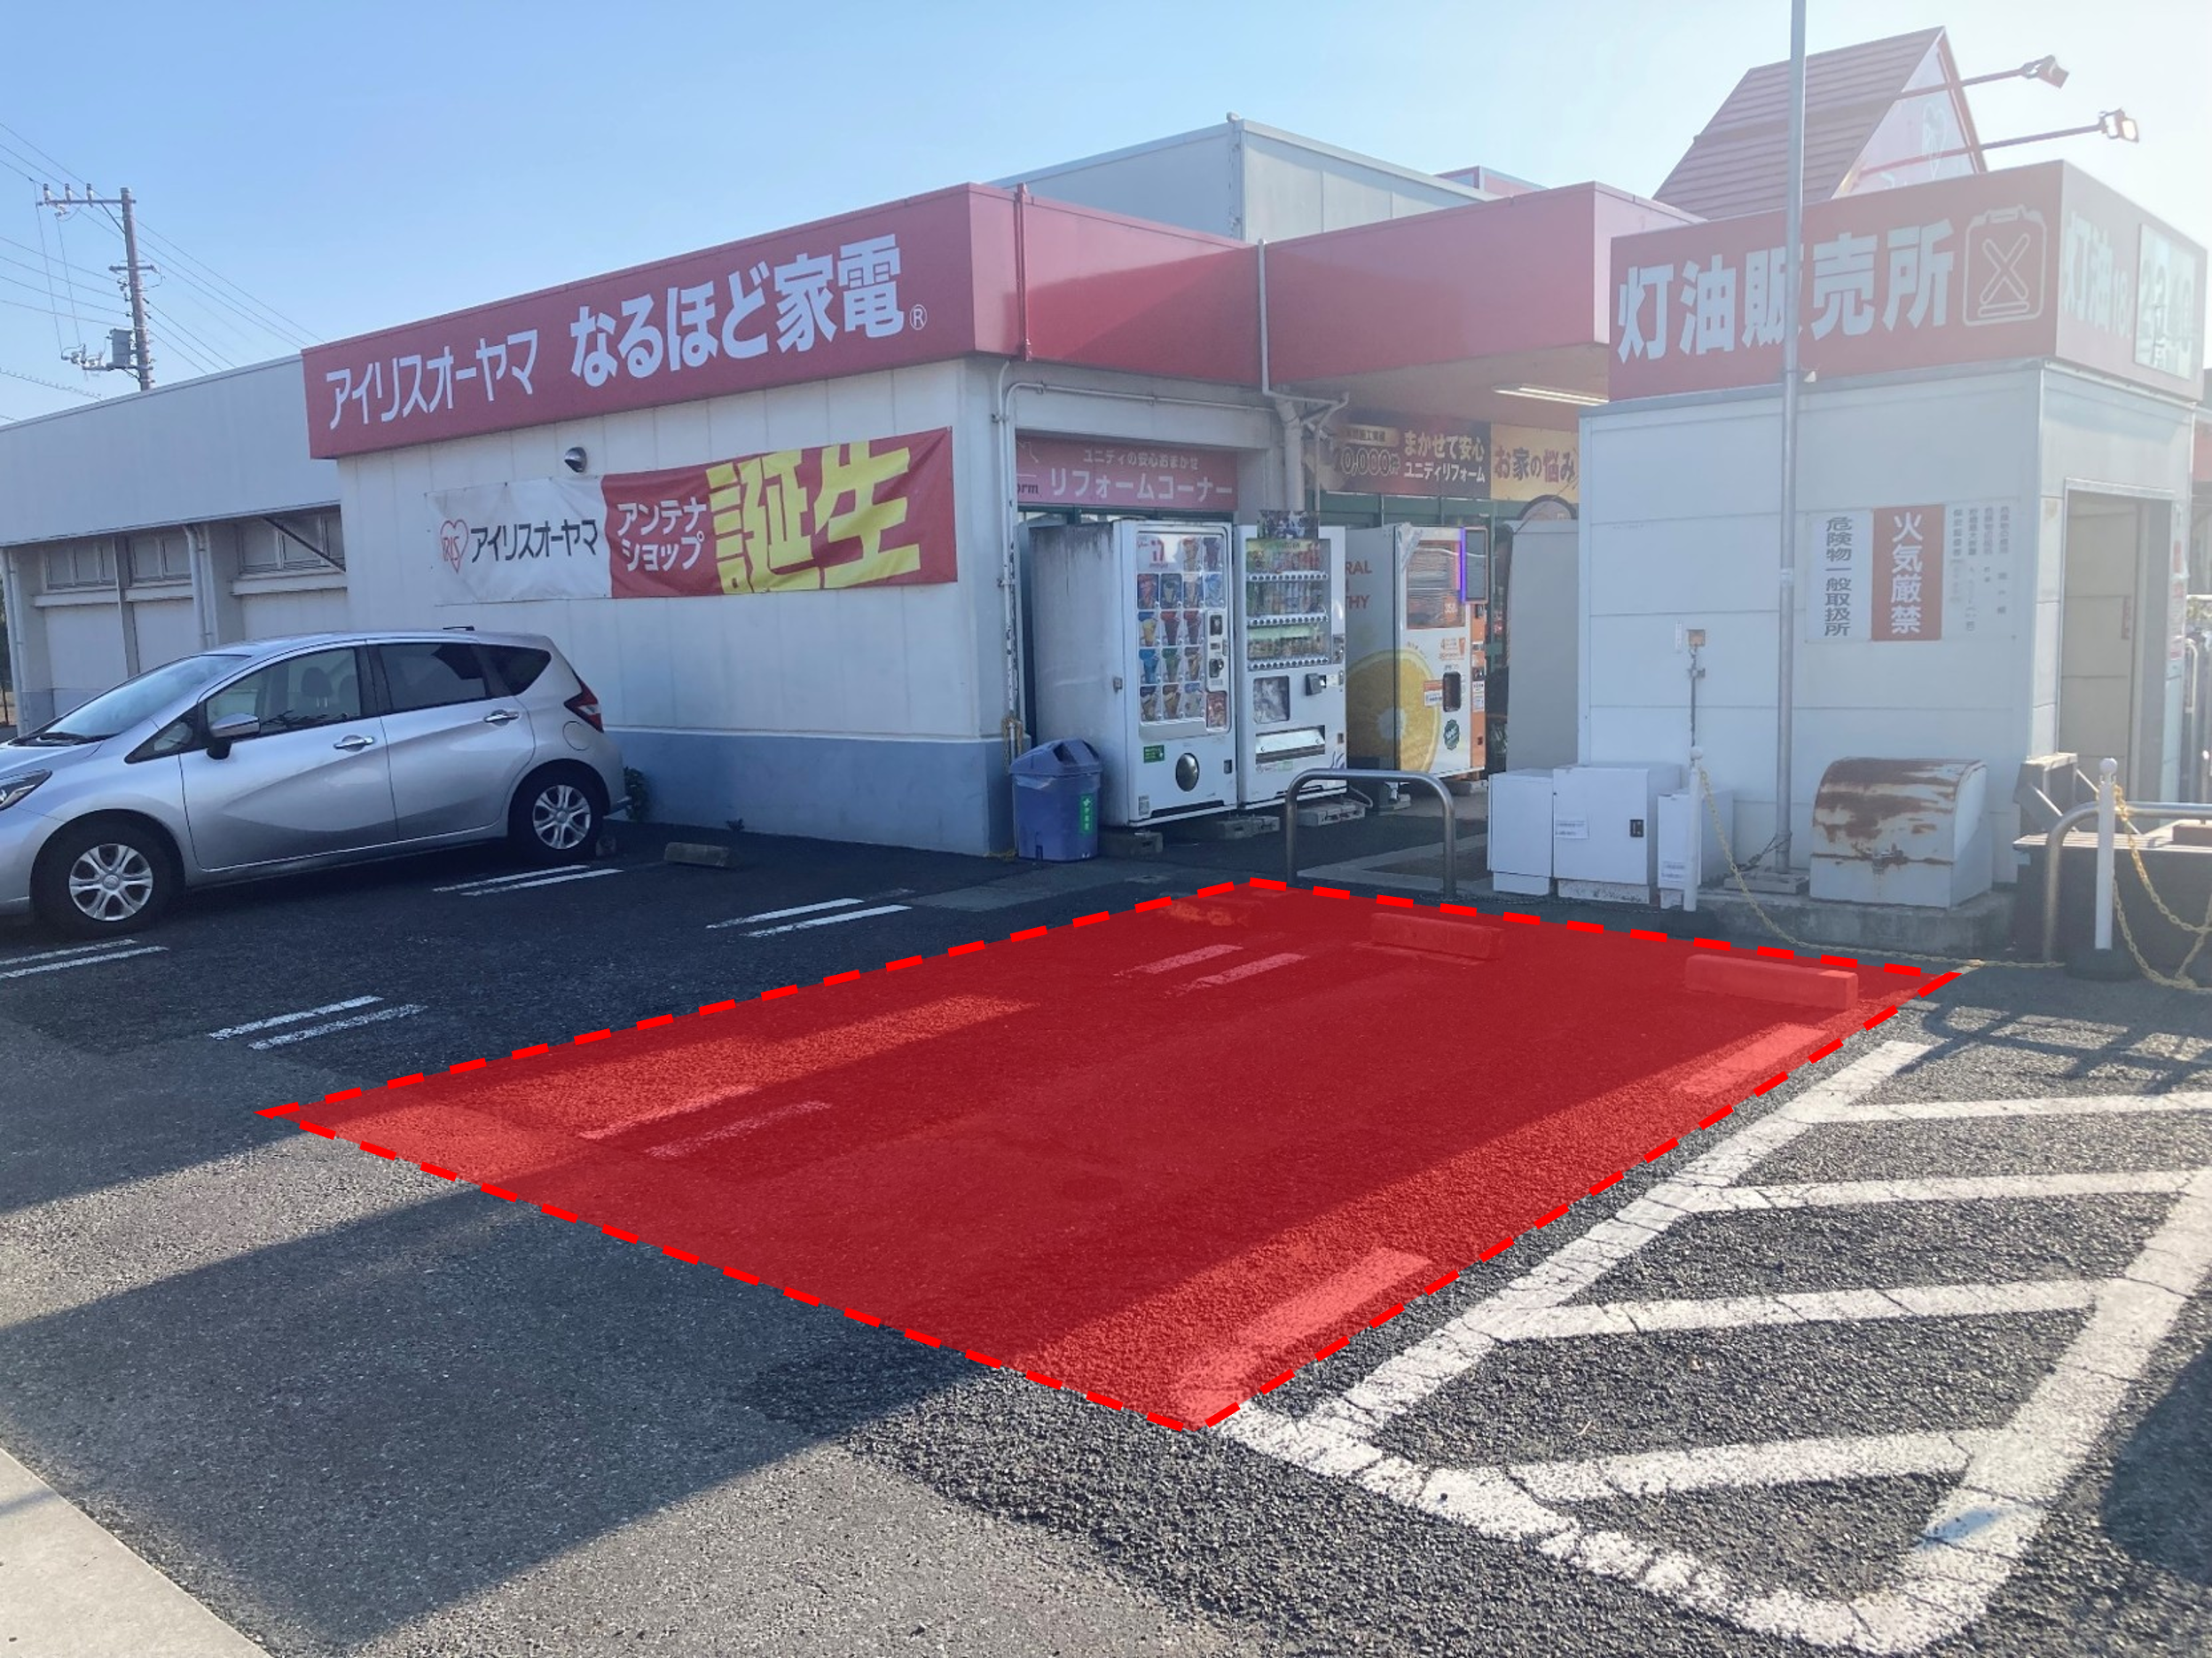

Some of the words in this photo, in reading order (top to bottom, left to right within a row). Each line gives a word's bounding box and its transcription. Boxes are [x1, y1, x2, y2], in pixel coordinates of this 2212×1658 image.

[1617, 222, 1955, 363] 灯油販売所
[326, 330, 537, 429] アイリスオーヤマ
[1404, 430, 1484, 461] まかせて安心
[1051, 468, 1233, 503] リフォームコーナー
[1404, 461, 1486, 483] ユニディリフォーム
[617, 498, 707, 535] アンテナ
[707, 441, 921, 593] 誕生
[470, 520, 598, 563] アイリスオーヤマ
[622, 533, 703, 572] ショップ
[1824, 516, 1852, 637] 危険物一般取扱所
[1890, 512, 1923, 634] 火気厳禁
